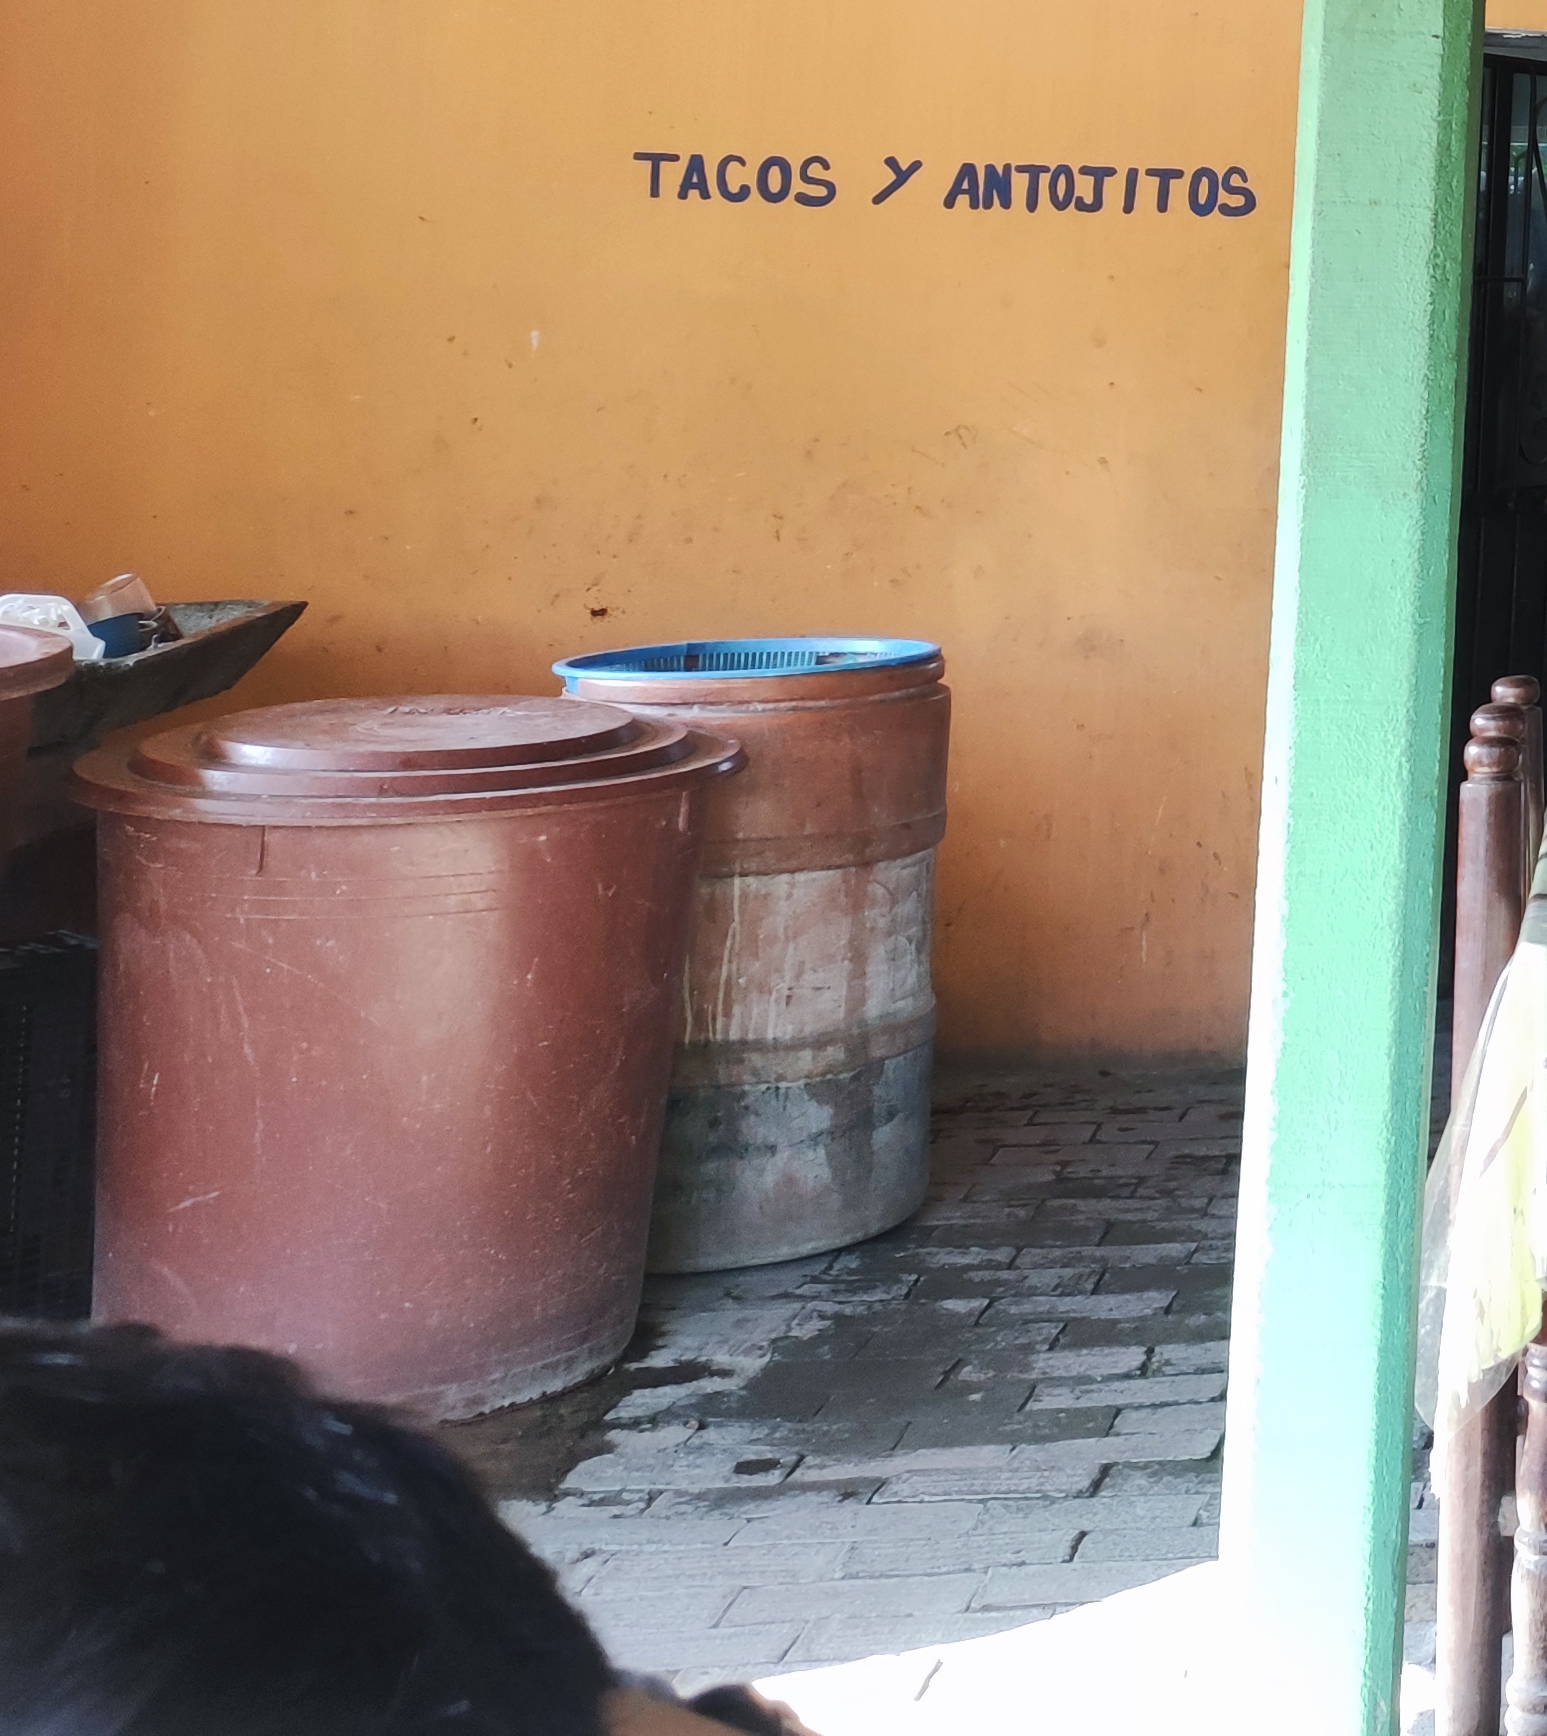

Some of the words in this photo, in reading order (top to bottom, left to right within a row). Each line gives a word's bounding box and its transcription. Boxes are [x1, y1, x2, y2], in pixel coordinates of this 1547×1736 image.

[632, 151, 838, 208] TACOS
[871, 155, 923, 206] Y
[942, 162, 1258, 218] ANTOJITOS
